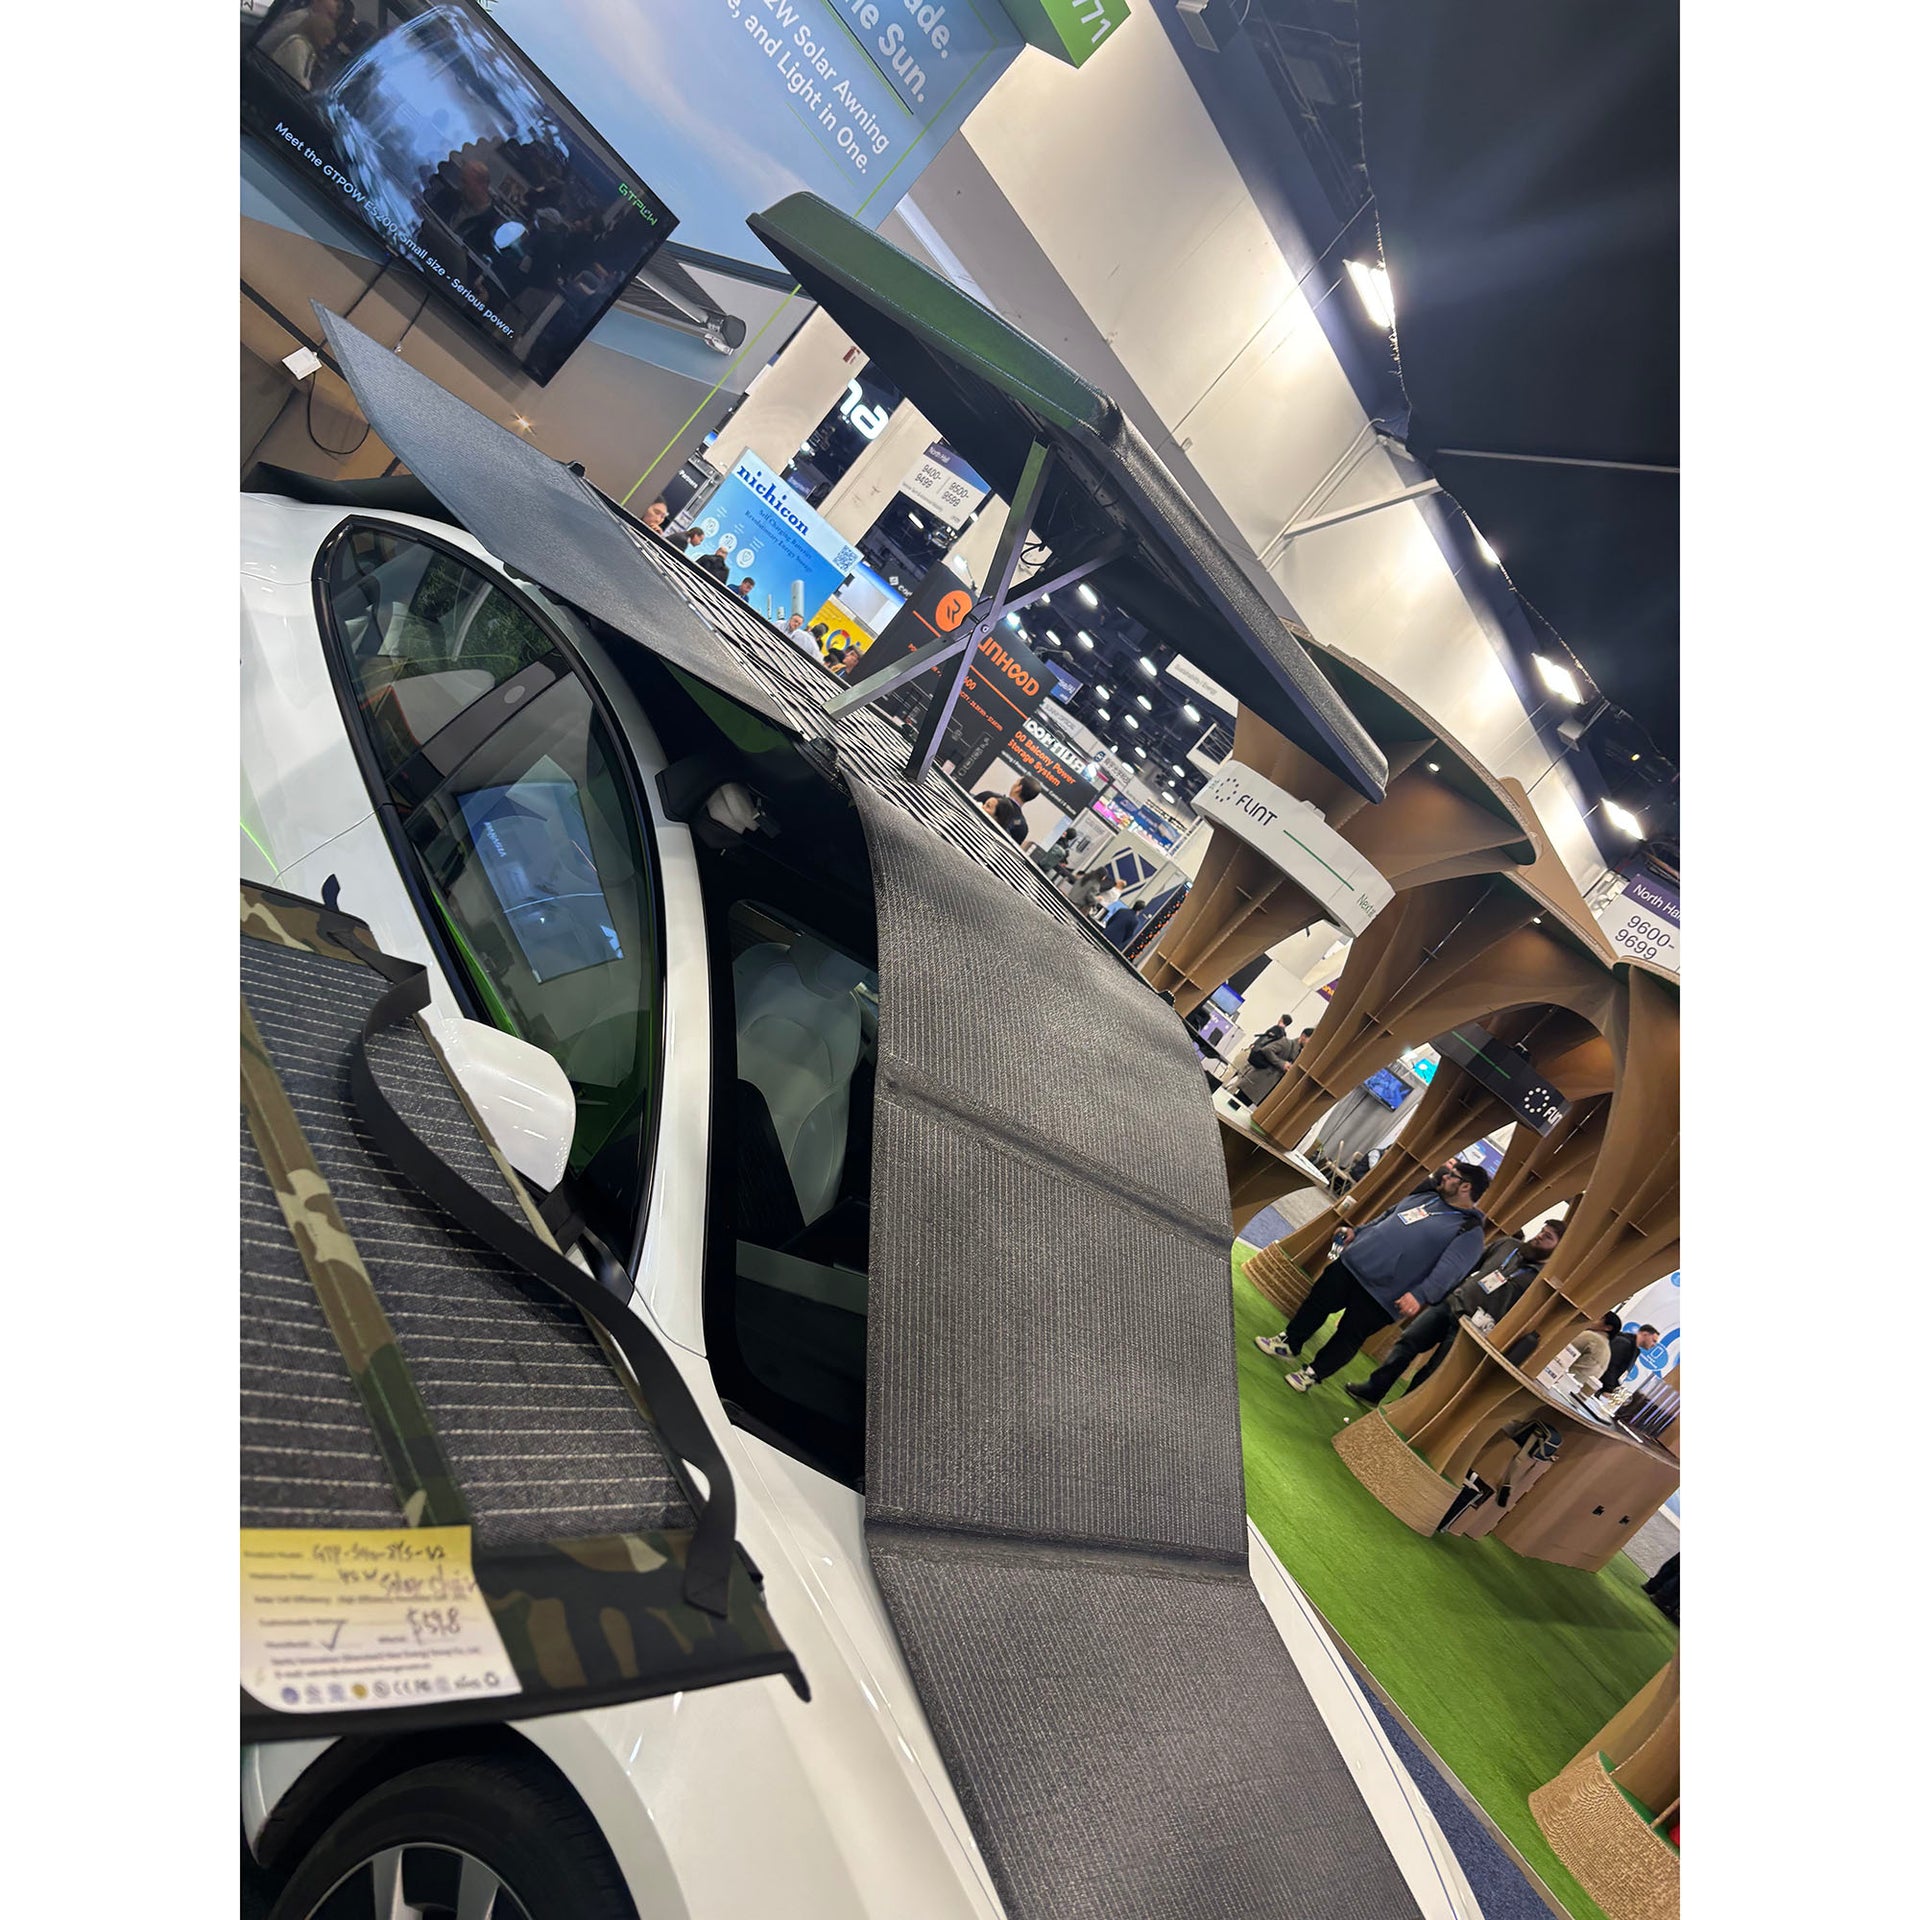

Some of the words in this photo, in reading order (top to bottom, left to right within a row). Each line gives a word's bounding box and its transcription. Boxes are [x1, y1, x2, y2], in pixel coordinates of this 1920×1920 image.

[879, 23, 925, 102] Sun.
[744, 14, 782, 56] and
[775, 53, 822, 110] Light
[818, 107, 838, 131] in
[835, 127, 869, 174] One.
[793, 25, 838, 80] Solar
[832, 80, 889, 153] Awning
[274, 121, 306, 151] Meet
[302, 146, 324, 167] the
[321, 162, 366, 204] GTPOW
[397, 230, 429, 260] Small
[425, 254, 447, 276] size
[449, 277, 487, 312] Serious
[482, 308, 517, 340] power.
[921, 463, 943, 482] 9400-
[948, 481, 971, 500] 9500-
[736, 463, 810, 536] nichicon
[1022, 738, 1055, 768] Balcony
[1051, 761, 1078, 785] Power
[1032, 760, 1062, 787] System
[1234, 791, 1278, 830] FLINT
[1632, 883, 1664, 908] North
[1614, 927, 1658, 961] 9699
[1626, 913, 1678, 952] 9600-
